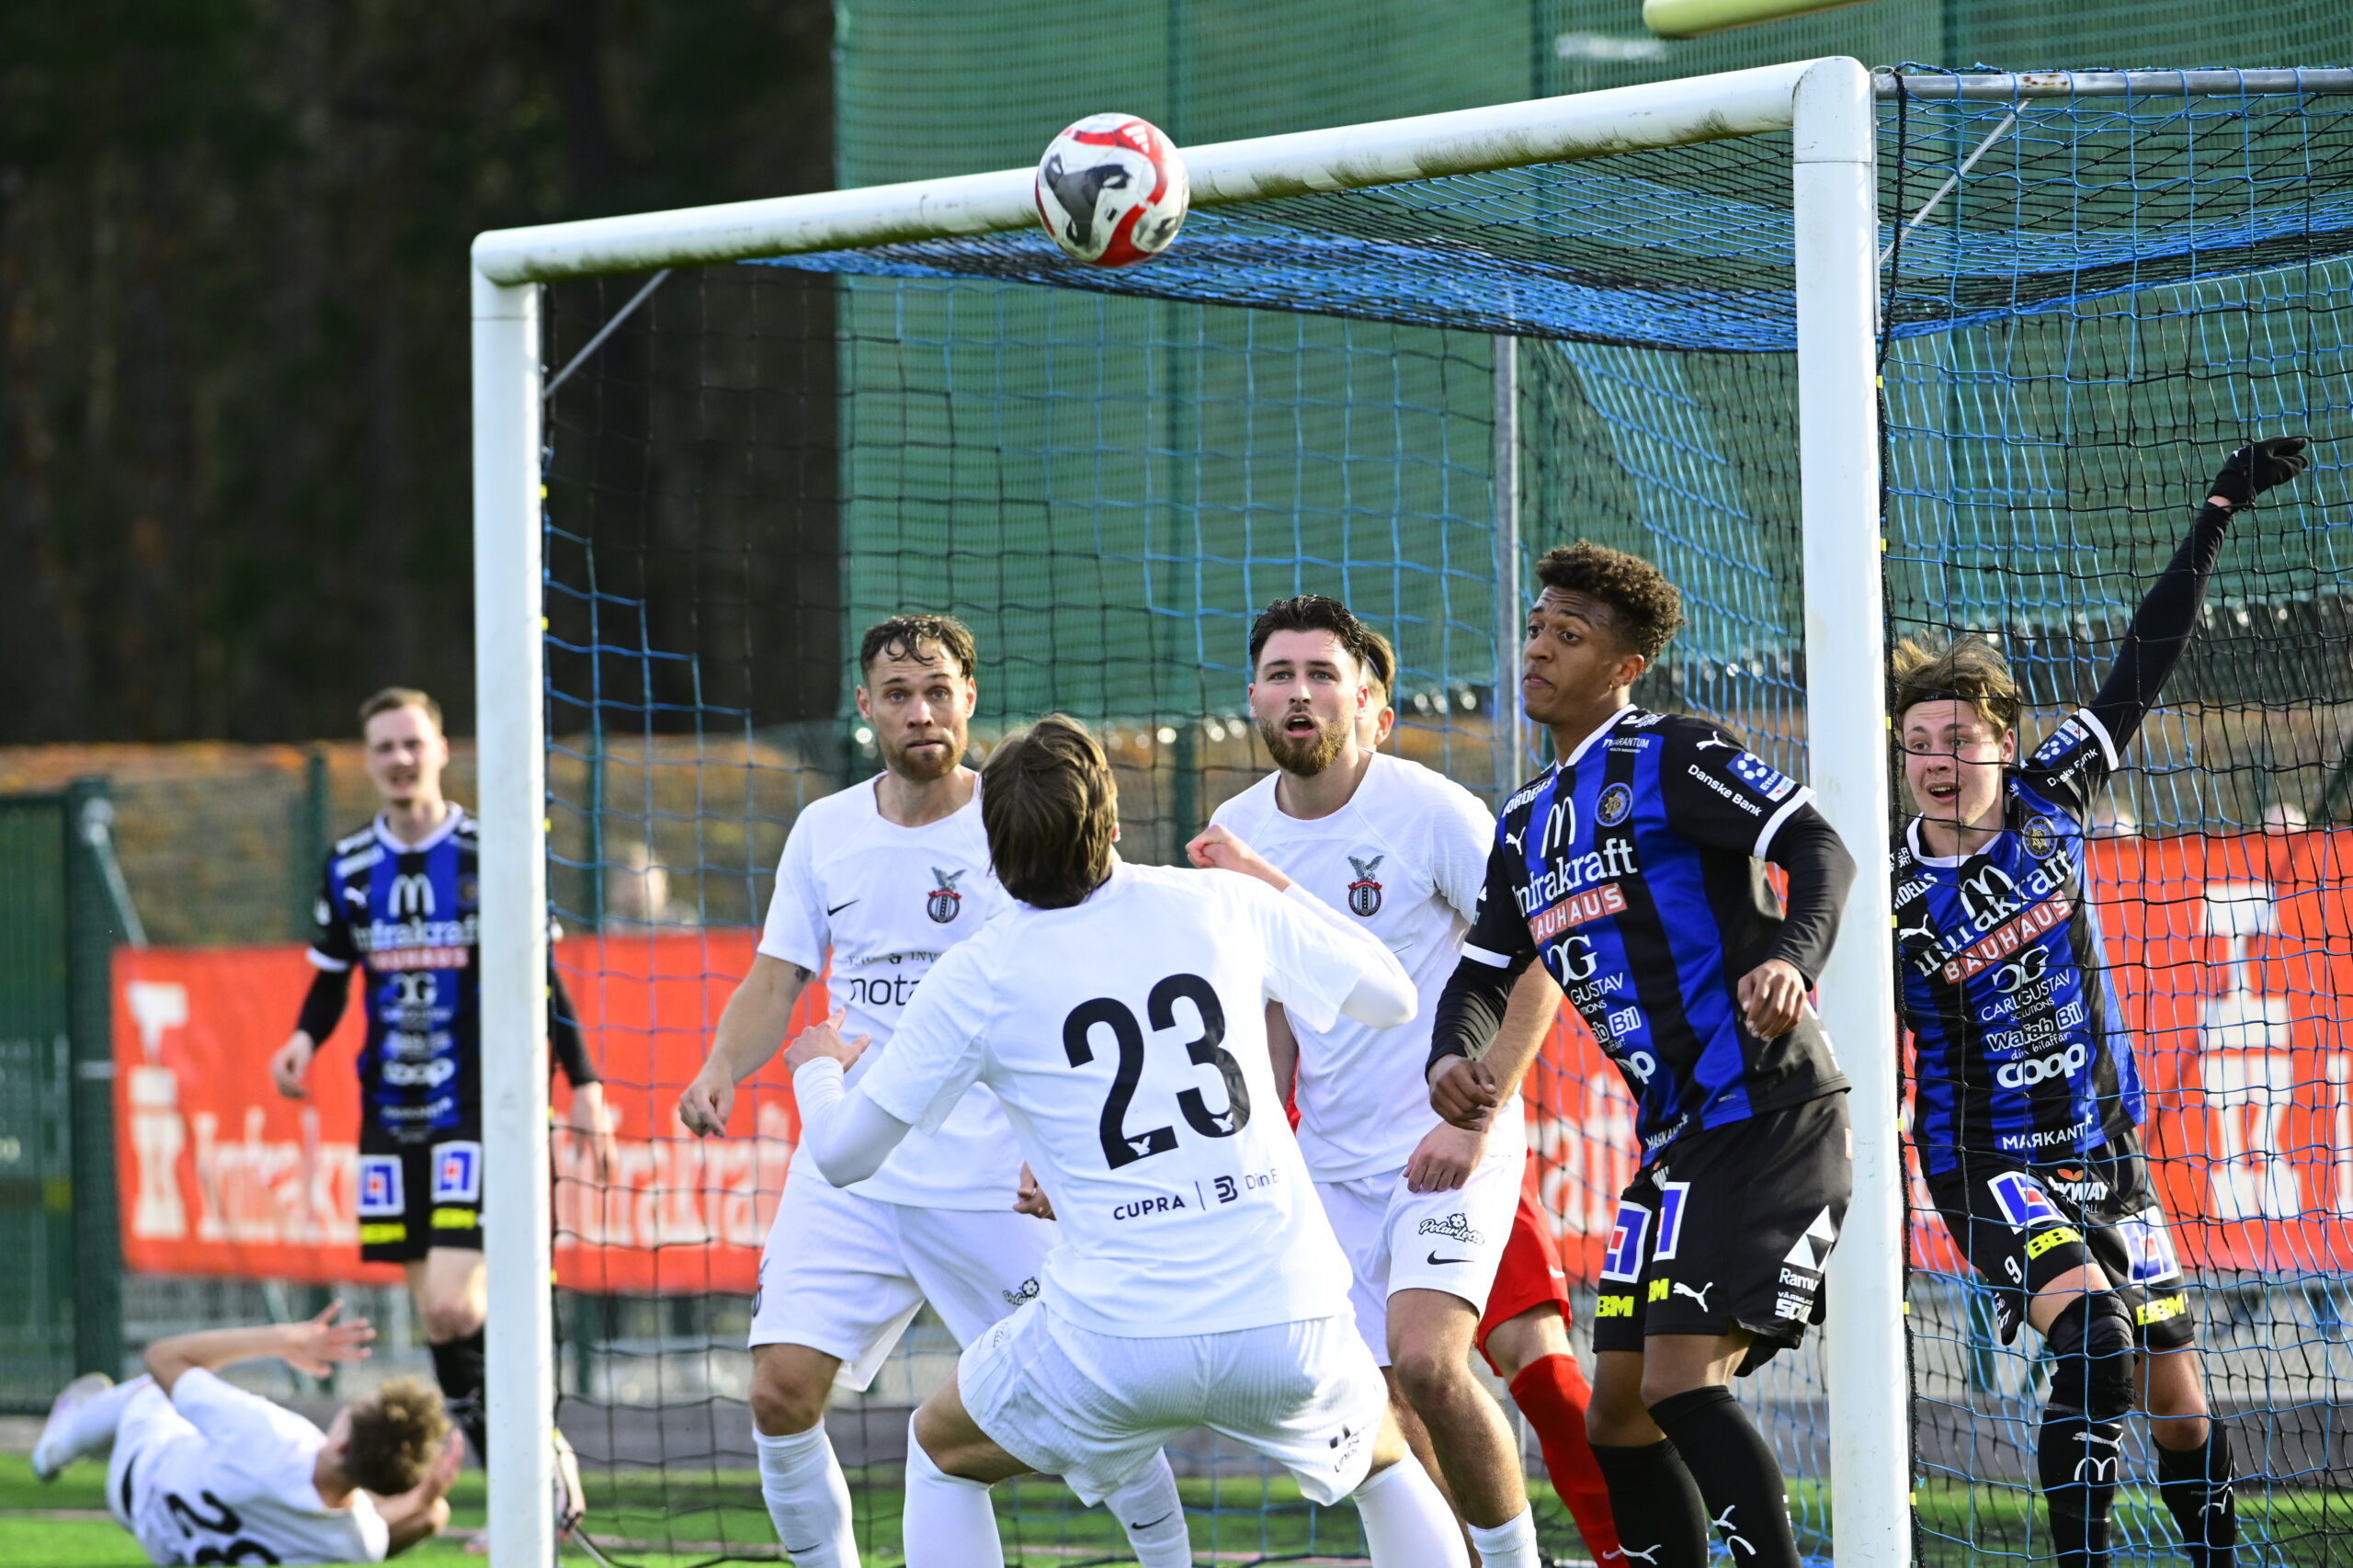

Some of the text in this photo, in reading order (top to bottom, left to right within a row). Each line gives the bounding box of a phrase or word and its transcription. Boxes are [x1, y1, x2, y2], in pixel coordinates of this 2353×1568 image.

[1688, 764, 1763, 817] Danske Bank
[1944, 894, 2070, 983] BAUHAUS
[849, 973, 921, 1006] not
[1570, 971, 1623, 1006] GUSTAV
[1608, 1006, 1643, 1037] Bil
[2055, 1001, 2084, 1030] Bil
[1063, 972, 1251, 1170] 23
[1996, 1042, 2088, 1089] coop
[1113, 1195, 1186, 1221] CUPRA
[2004, 1256, 2023, 1285] 9
[1595, 1295, 1634, 1317] BM
